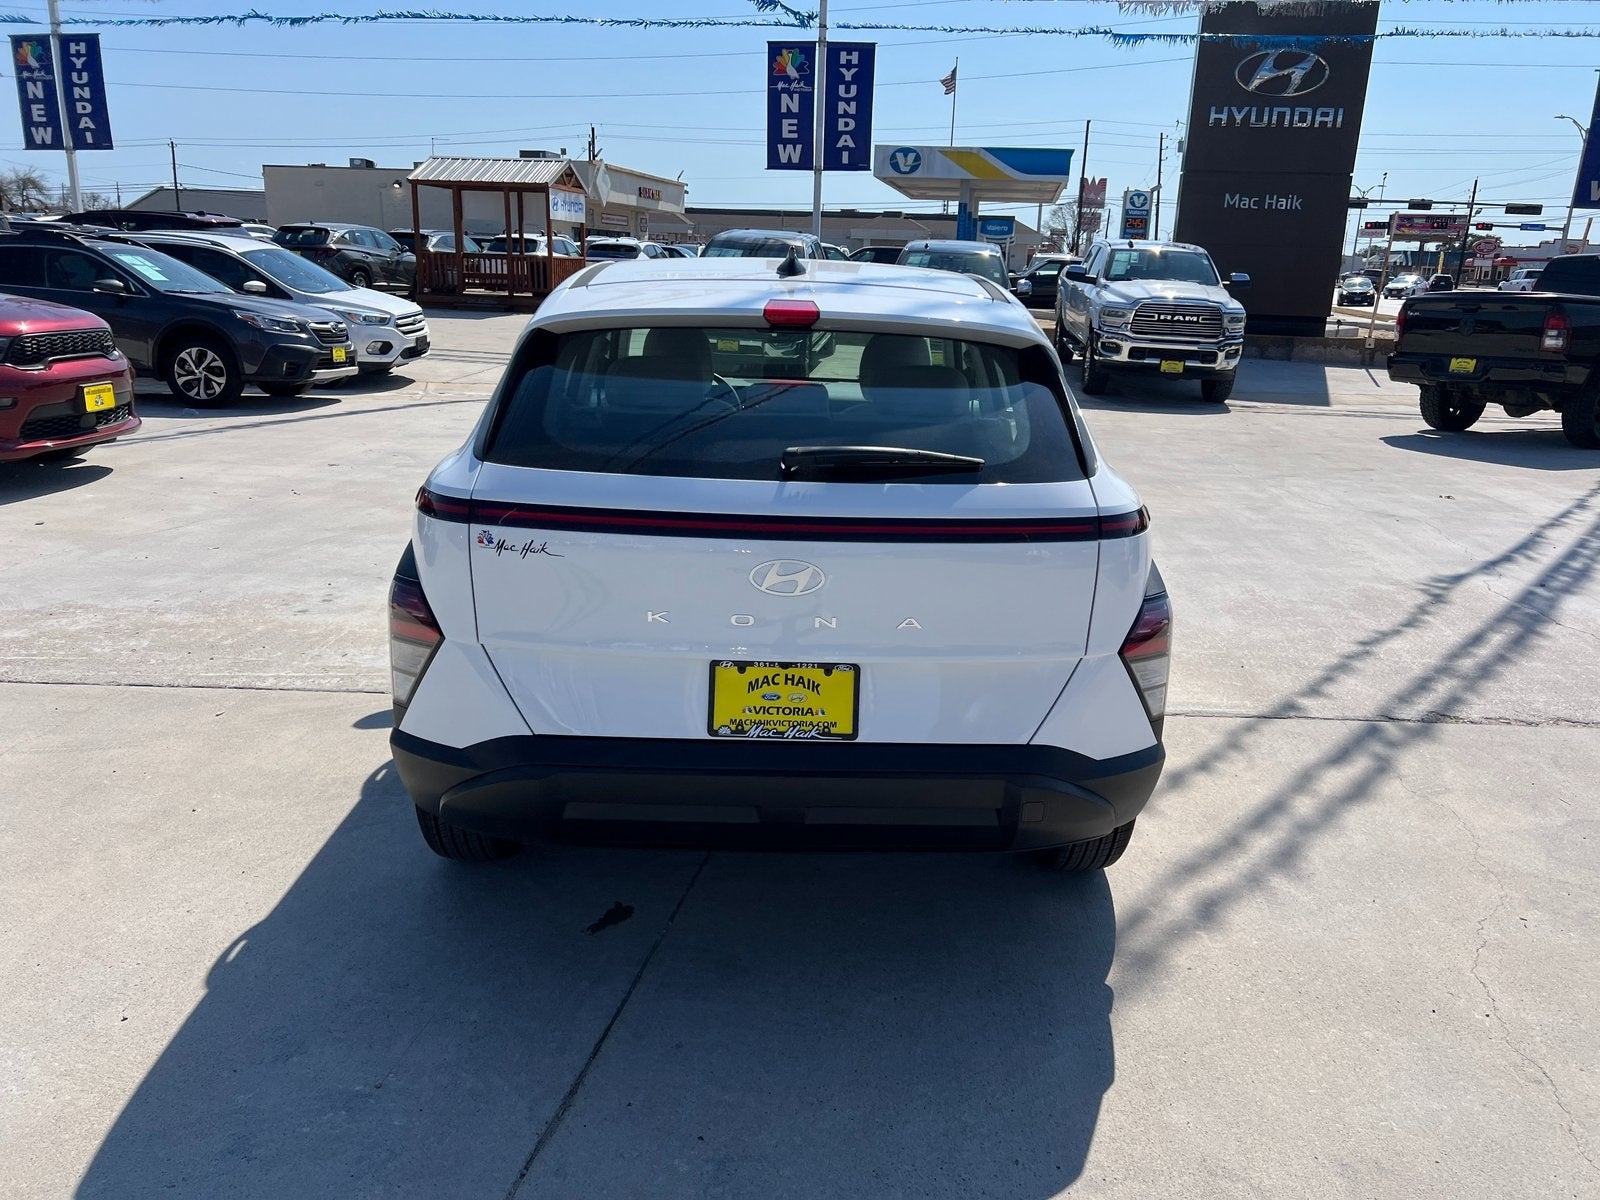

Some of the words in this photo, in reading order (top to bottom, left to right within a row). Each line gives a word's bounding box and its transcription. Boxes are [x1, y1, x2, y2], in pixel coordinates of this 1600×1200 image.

[69, 42, 96, 144] HYUNDAI
[26, 81, 52, 145] NEW
[836, 51, 859, 164] HYUNDAI
[1208, 105, 1344, 128] HYUNDAI
[777, 93, 803, 164] NEW
[1224, 193, 1259, 209] Mac
[1264, 194, 1302, 210] Haik
[986, 224, 1008, 232] Valero
[1159, 314, 1198, 322] RAM
[493, 538, 519, 557] Mac
[520, 540, 561, 559] Haik
[647, 610, 922, 630] KONA
[747, 673, 780, 693] MAC
[784, 673, 821, 696] HAIK
[753, 706, 815, 717] VICTORIA
[741, 724, 783, 738] Mac
[783, 724, 834, 739] Haik
